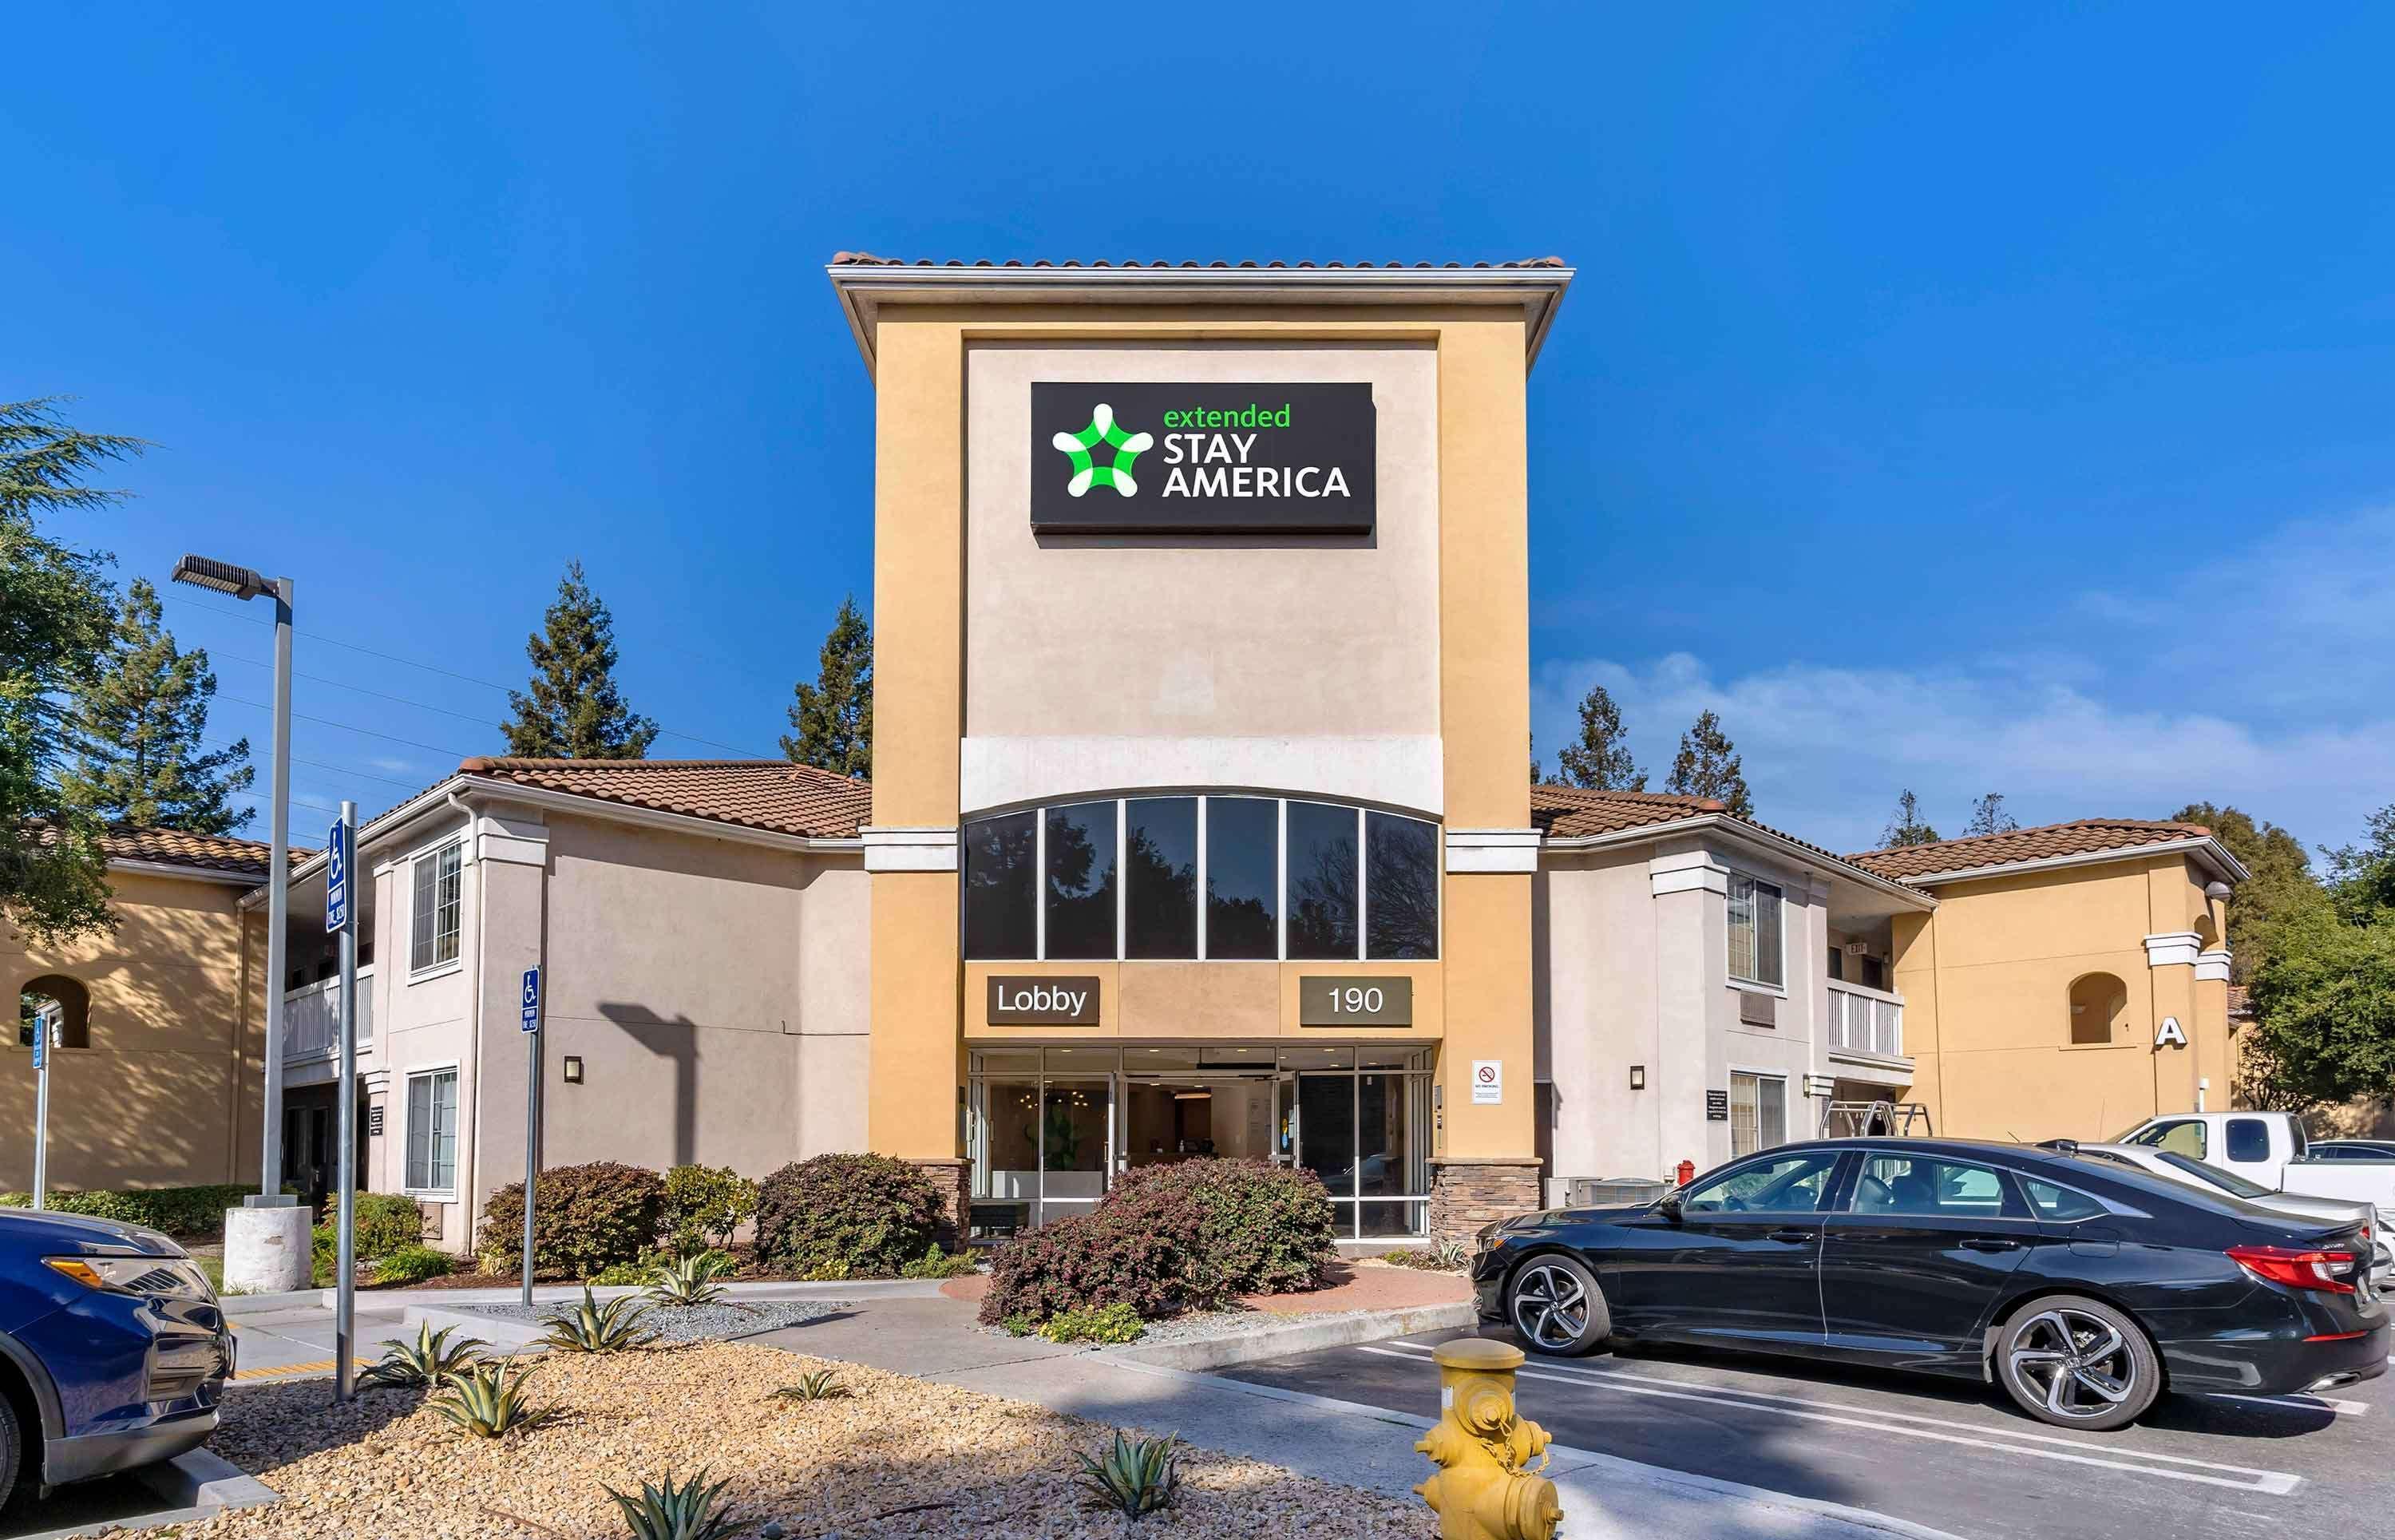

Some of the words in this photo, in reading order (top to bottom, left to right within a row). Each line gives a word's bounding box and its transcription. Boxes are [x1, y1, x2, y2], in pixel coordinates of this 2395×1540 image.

[1163, 403, 1290, 428] extended
[1163, 433, 1257, 464] STAY
[1162, 466, 1352, 497] AMERICA
[998, 985, 1087, 1016] Lobby
[1328, 987, 1383, 1013] 190
[2155, 1016, 2187, 1045] A
